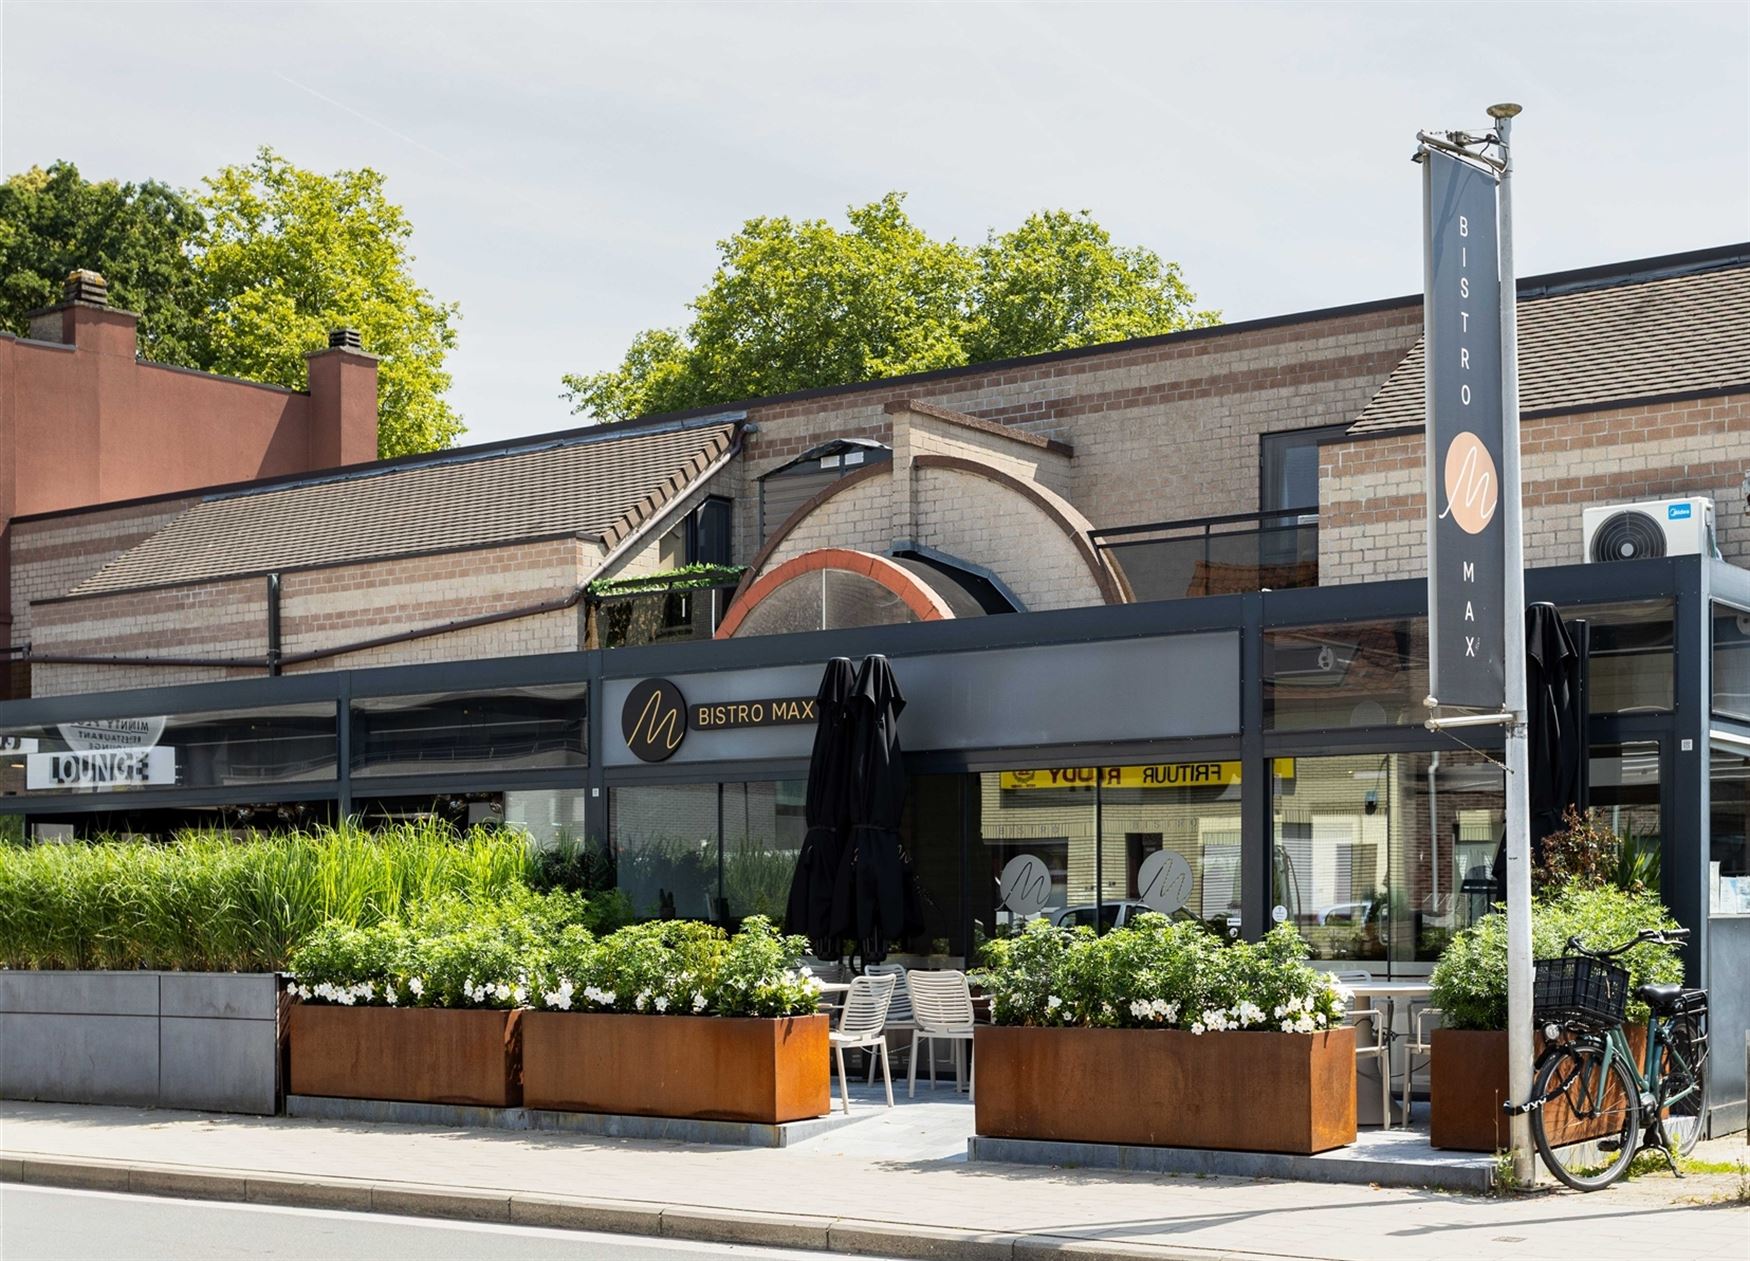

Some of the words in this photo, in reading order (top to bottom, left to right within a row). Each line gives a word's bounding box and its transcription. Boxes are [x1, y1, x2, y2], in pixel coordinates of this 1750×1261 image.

[1459, 215, 1471, 406] BISTRO
[1463, 561, 1475, 657] MAX
[699, 703, 764, 726] BISTRO
[771, 700, 815, 721] MAX
[51, 752, 149, 783] LOUNGE
